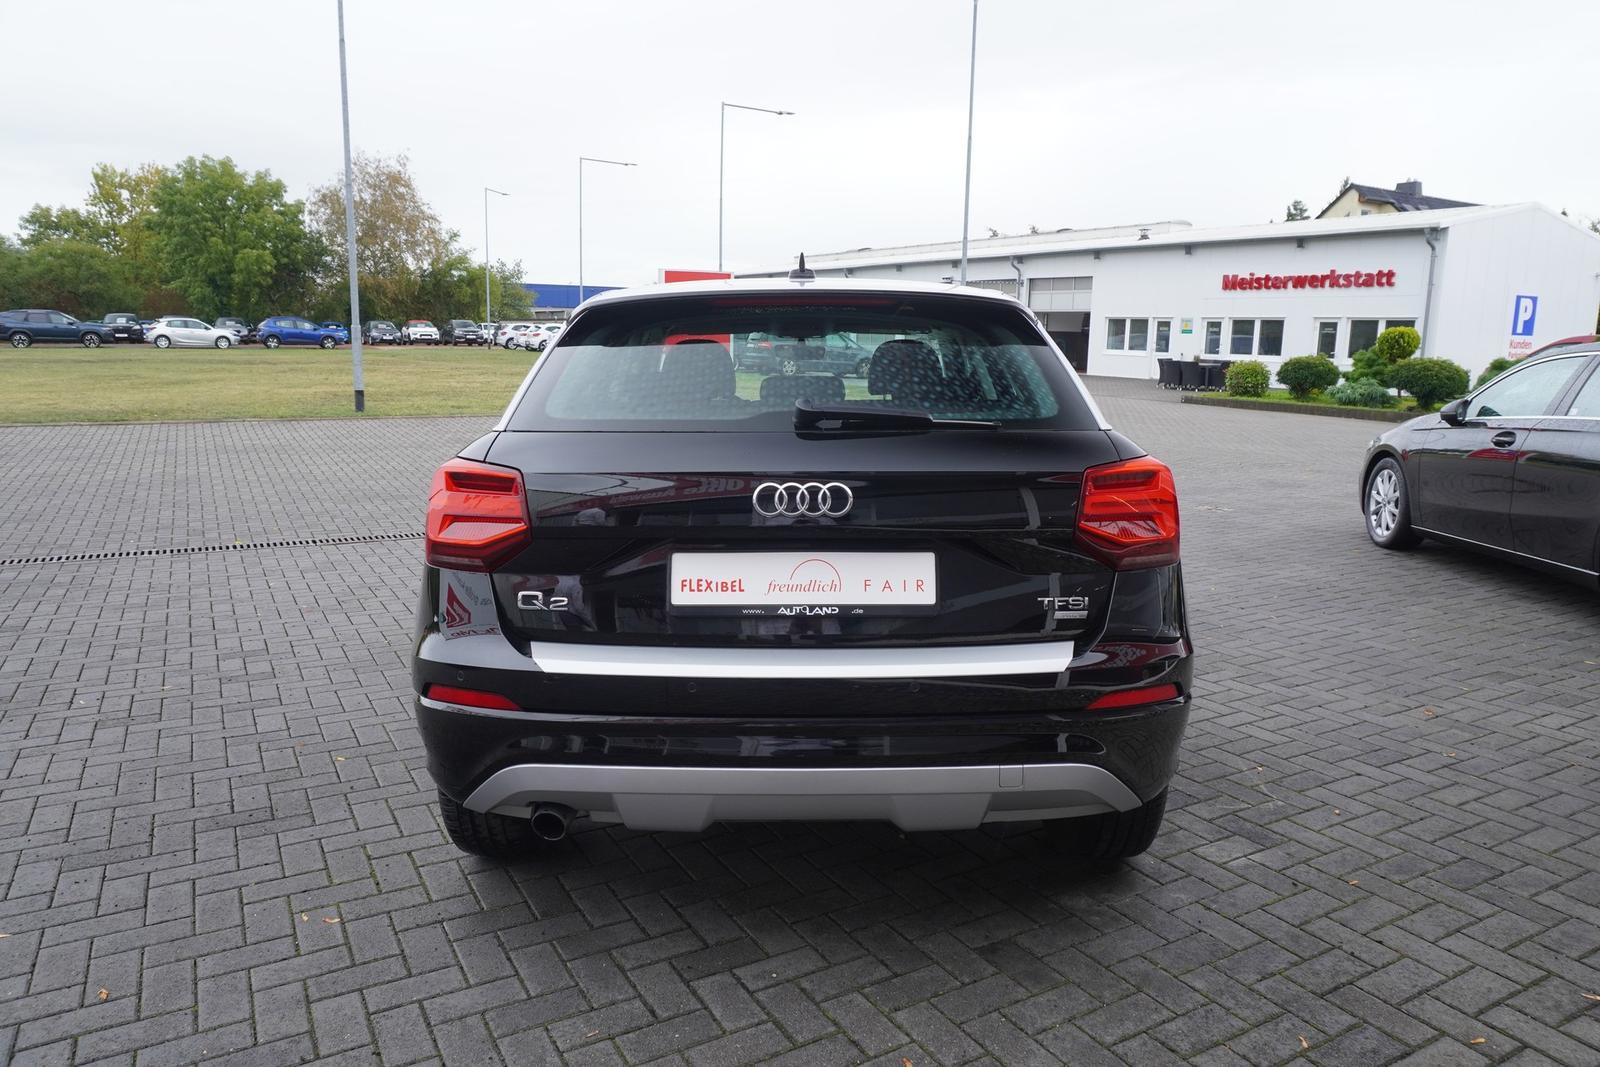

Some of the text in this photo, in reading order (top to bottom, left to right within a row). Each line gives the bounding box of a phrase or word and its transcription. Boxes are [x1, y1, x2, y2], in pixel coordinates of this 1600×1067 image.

[1221, 269, 1396, 292] Meisterwerkstatt
[1516, 297, 1534, 334] P
[764, 578, 838, 596] freundlich
[863, 579, 925, 593] FAIR
[517, 590, 568, 610] Q2
[1037, 596, 1089, 610] TFSI
[777, 605, 839, 616] AUTOLAND
